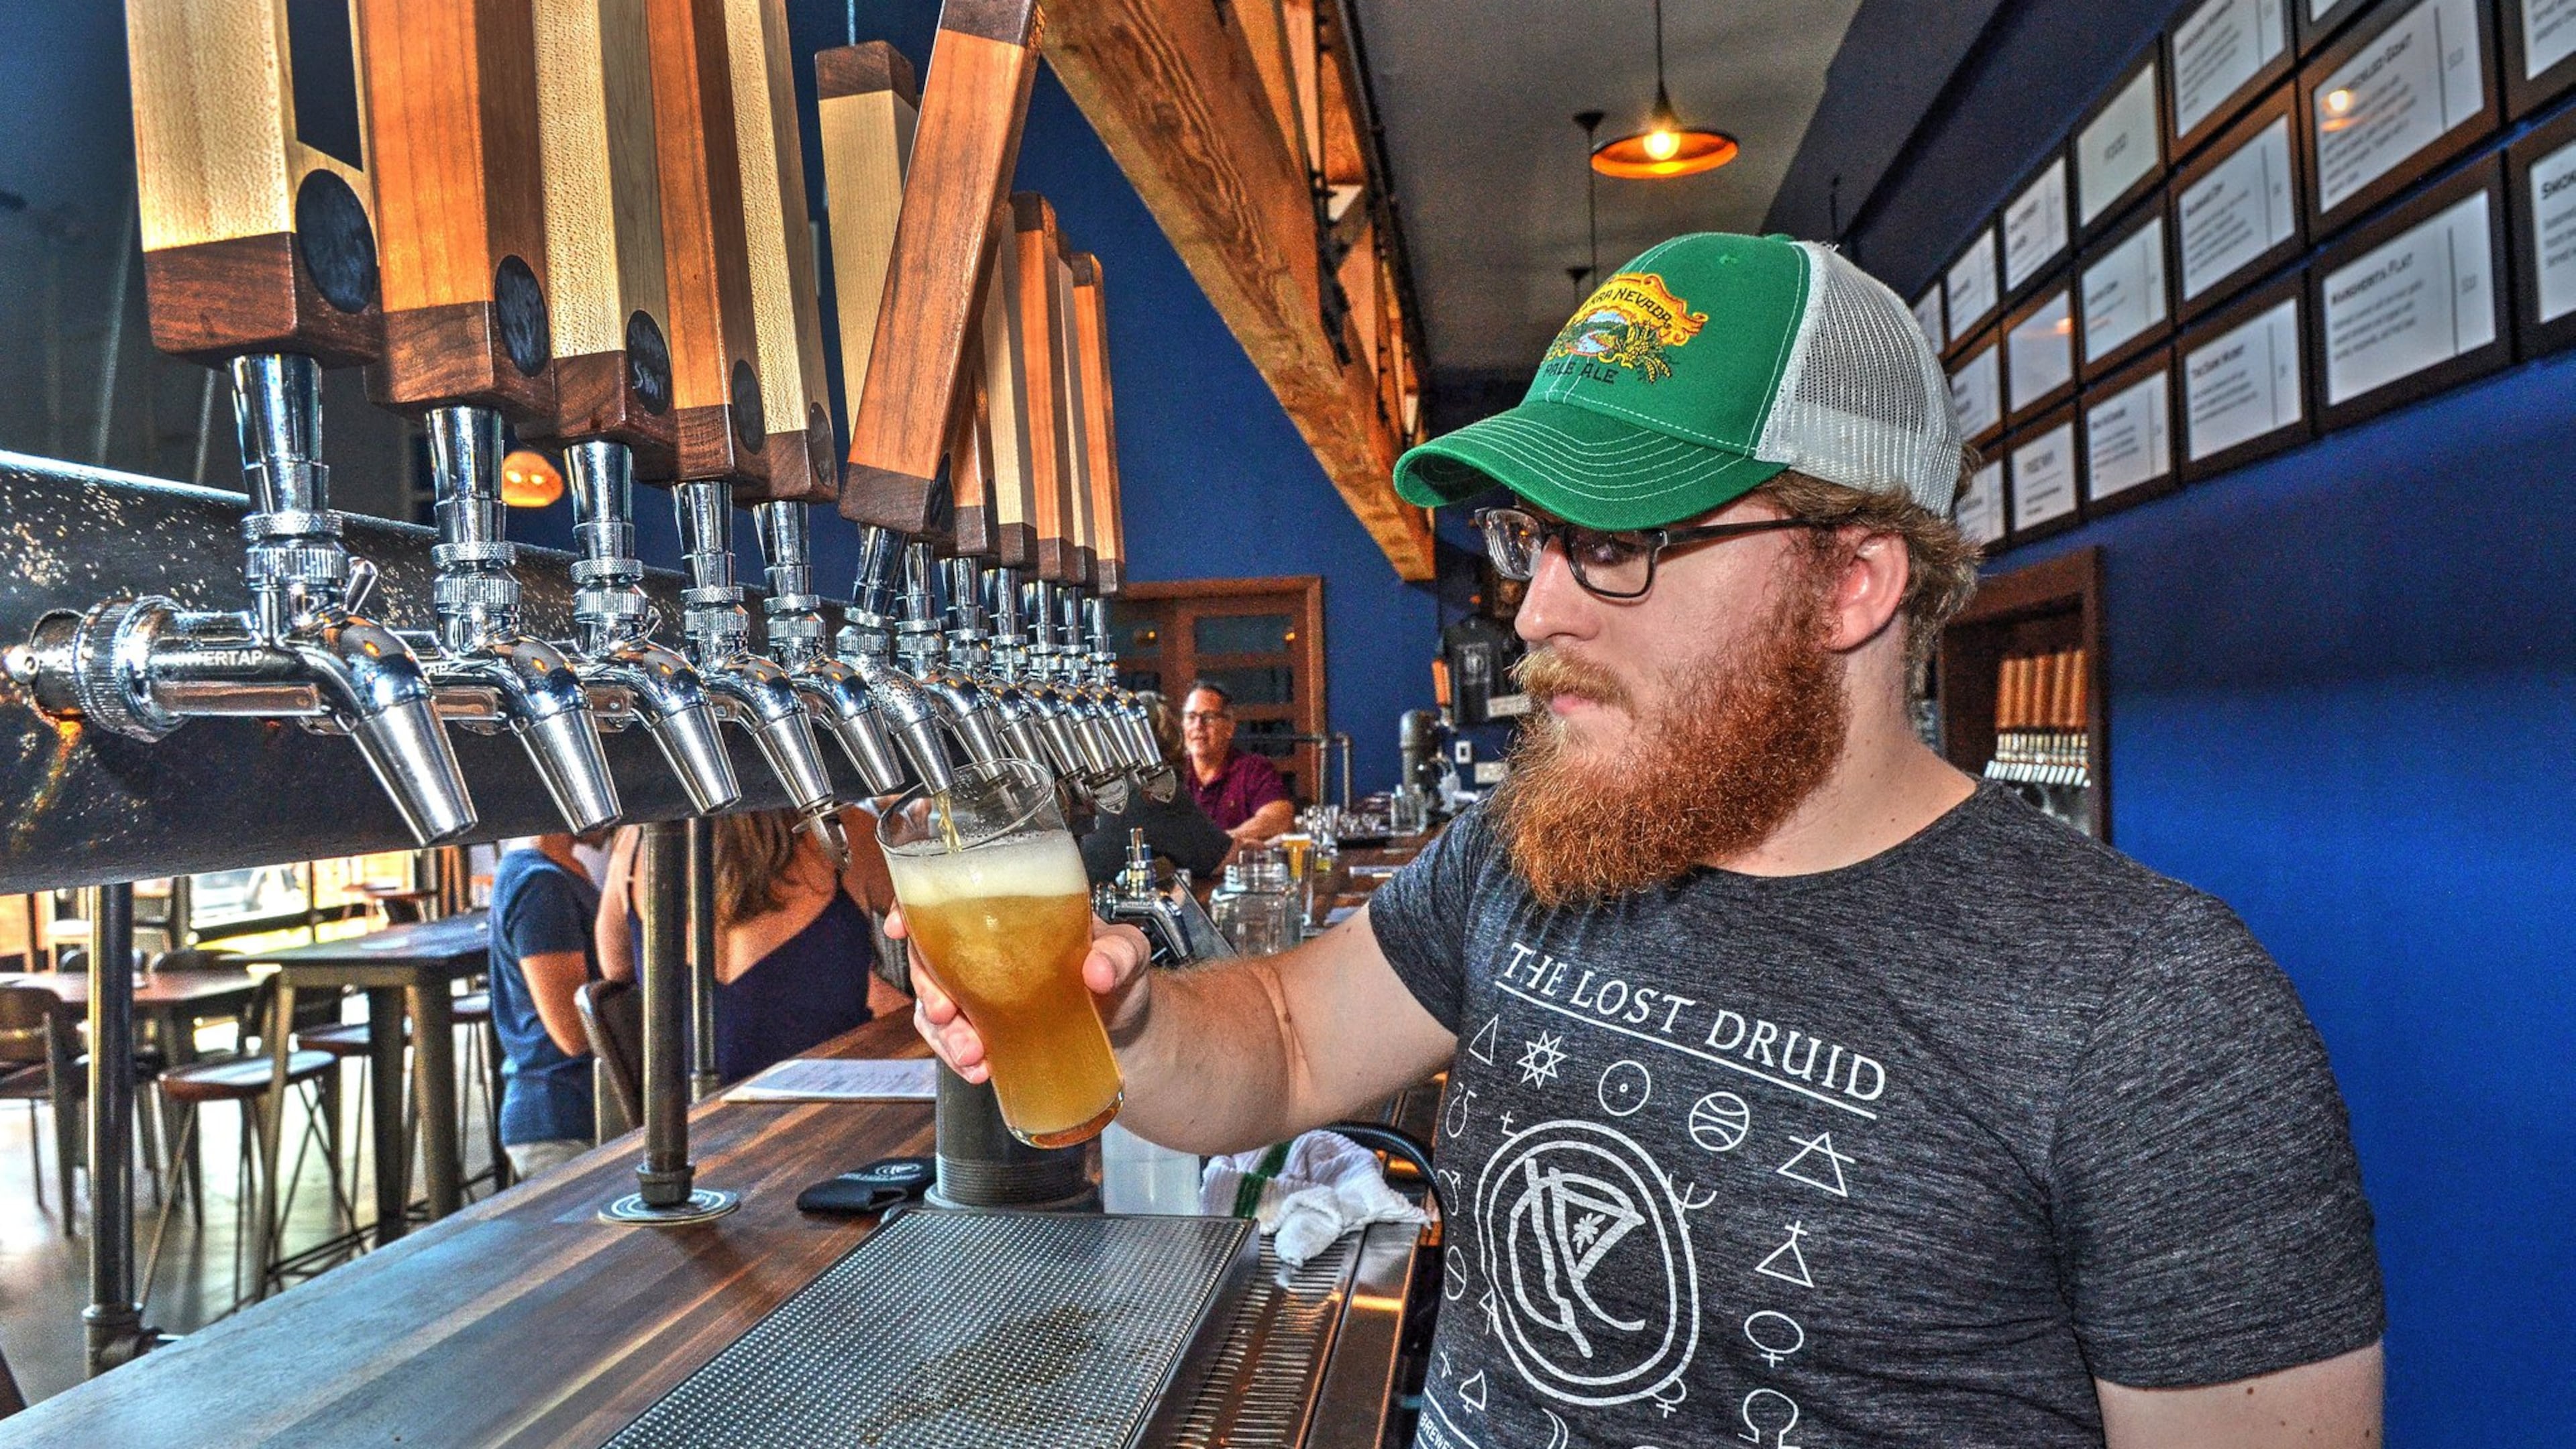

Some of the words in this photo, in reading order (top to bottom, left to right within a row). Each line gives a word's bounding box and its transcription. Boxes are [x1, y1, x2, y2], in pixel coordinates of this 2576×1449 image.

[1580, 363, 1619, 384] ALE
[1504, 941, 1568, 997] THE
[1570, 970, 1697, 1033] LOST
[1705, 1009, 1886, 1101] DRUID
